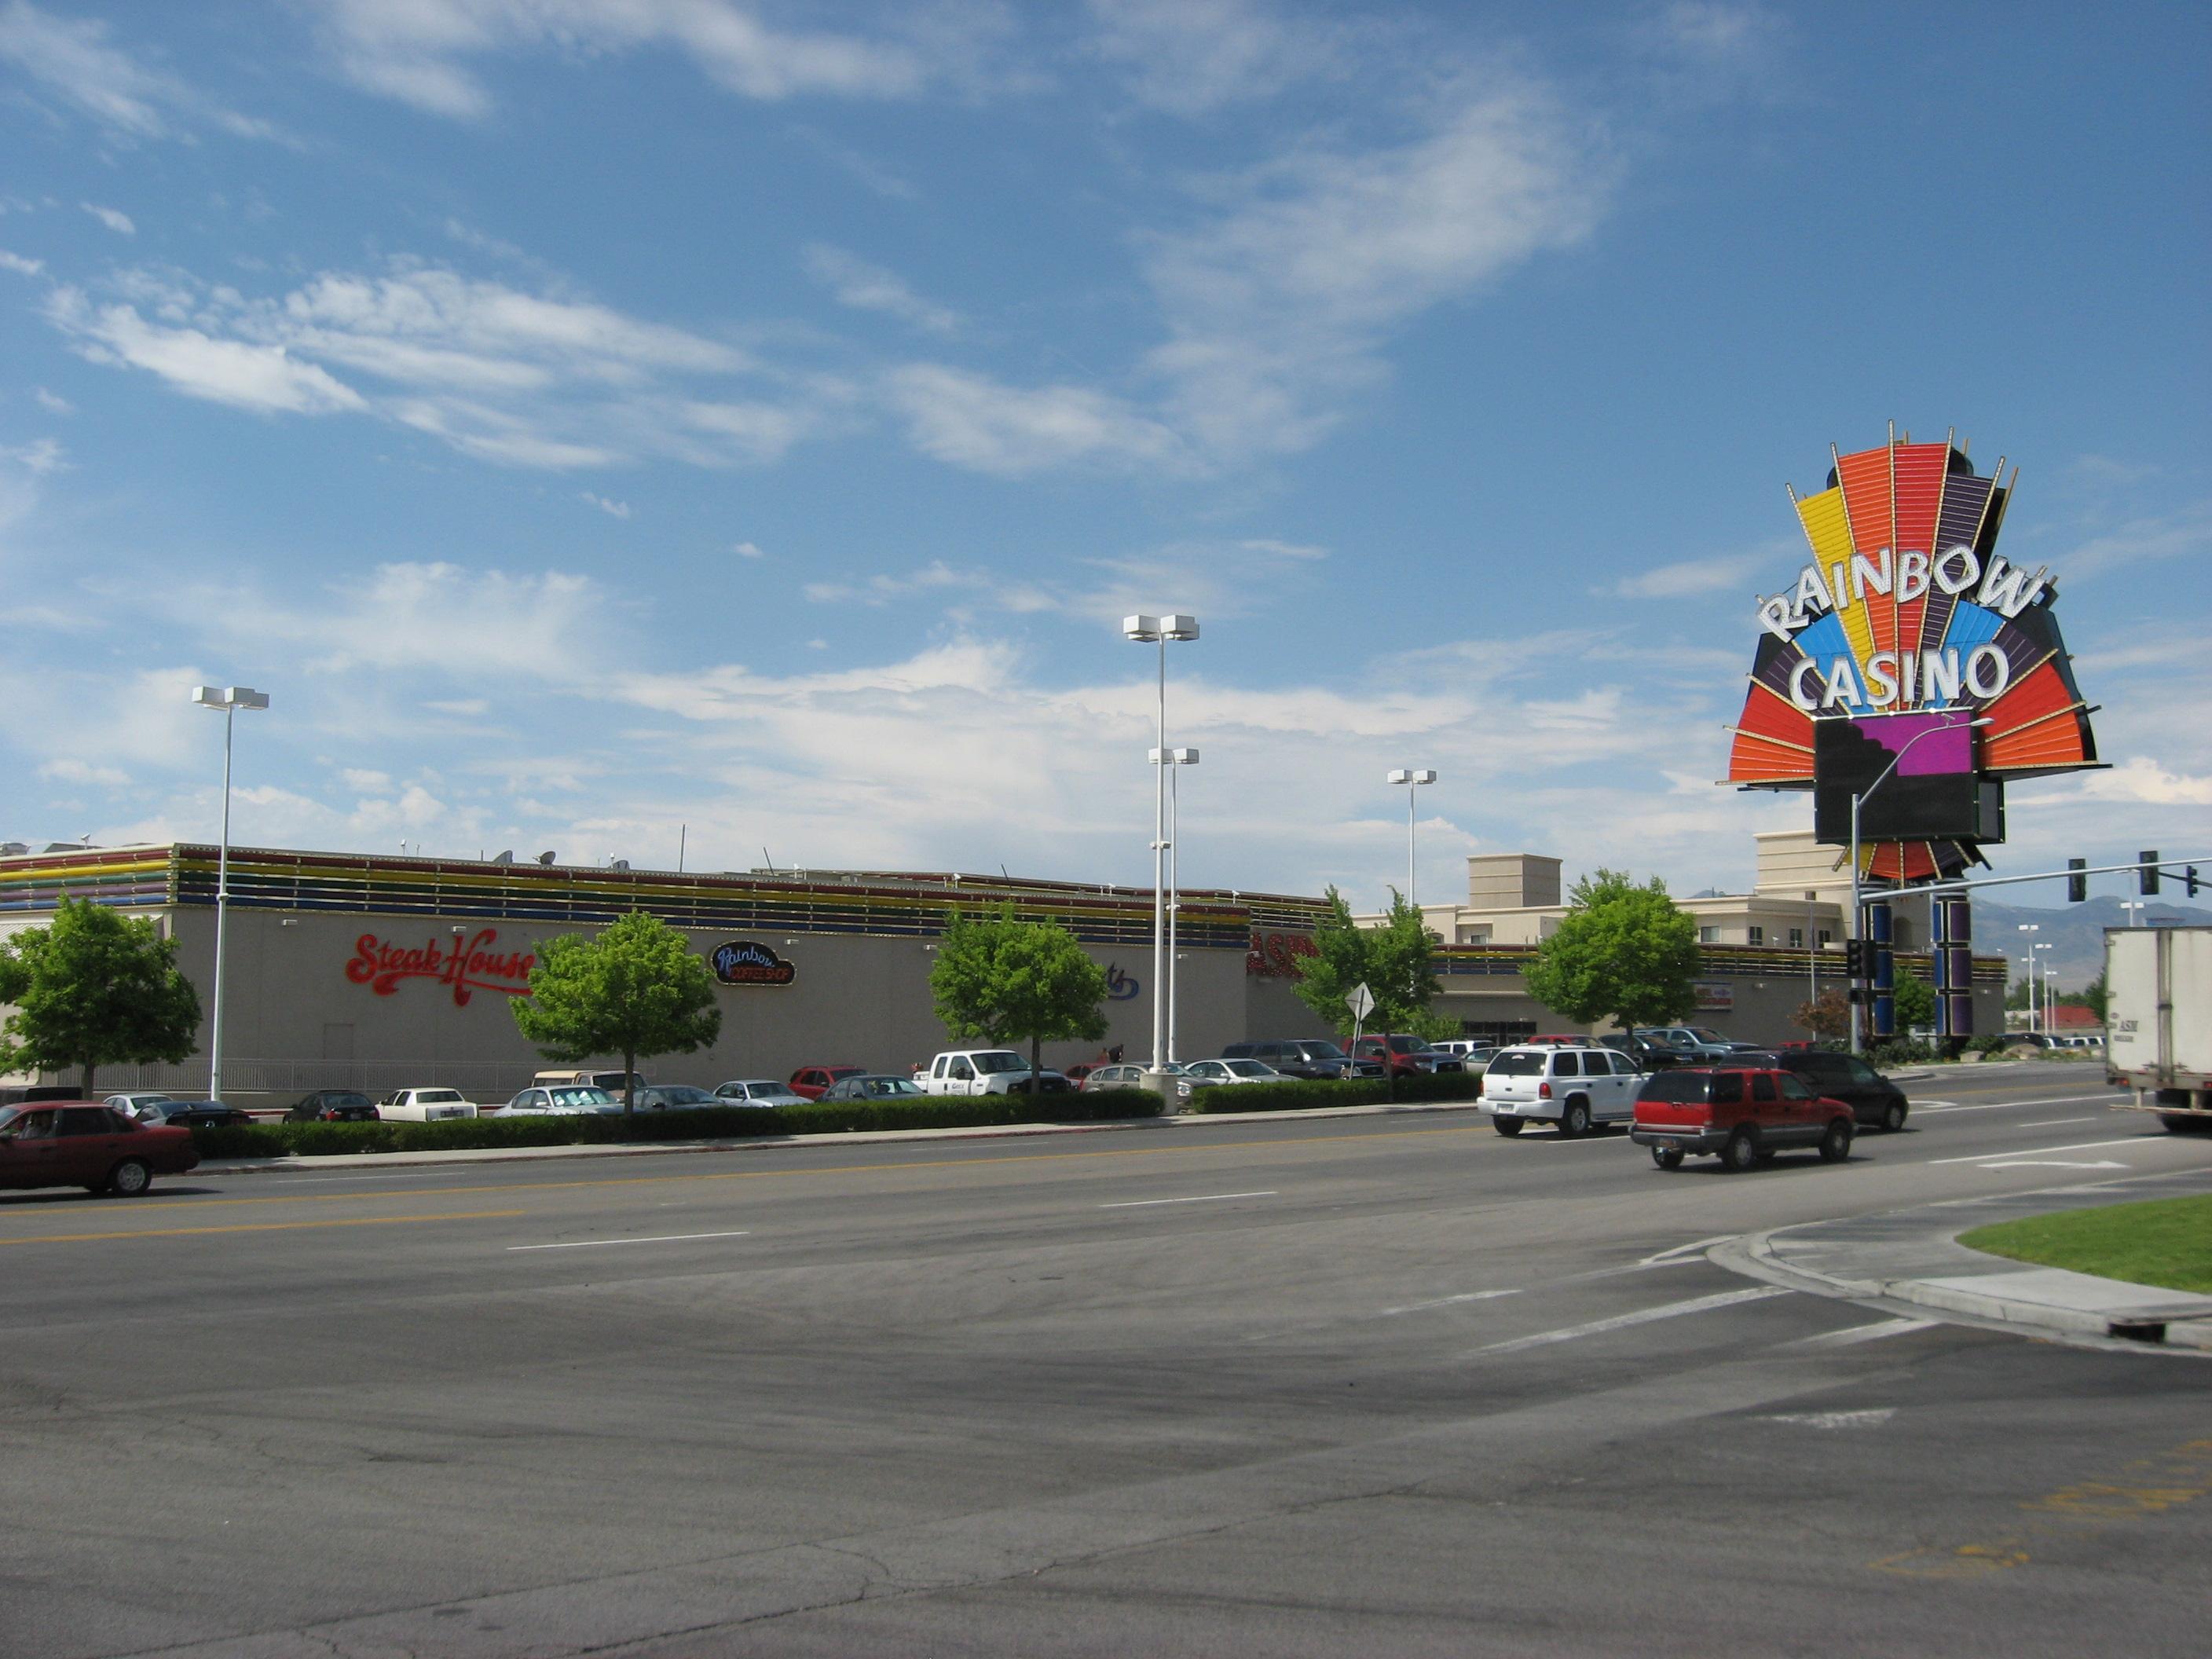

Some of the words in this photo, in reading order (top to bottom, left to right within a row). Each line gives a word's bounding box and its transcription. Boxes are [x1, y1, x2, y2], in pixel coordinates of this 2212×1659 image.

[1756, 544, 2046, 643] RAINBOW
[1789, 643, 2009, 710] CASINO
[346, 933, 442, 985] Steak
[440, 928, 536, 1006] House
[717, 946, 775, 978] Rainbow
[729, 966, 765, 980] COFFEE
[766, 968, 789, 980] SHOP
